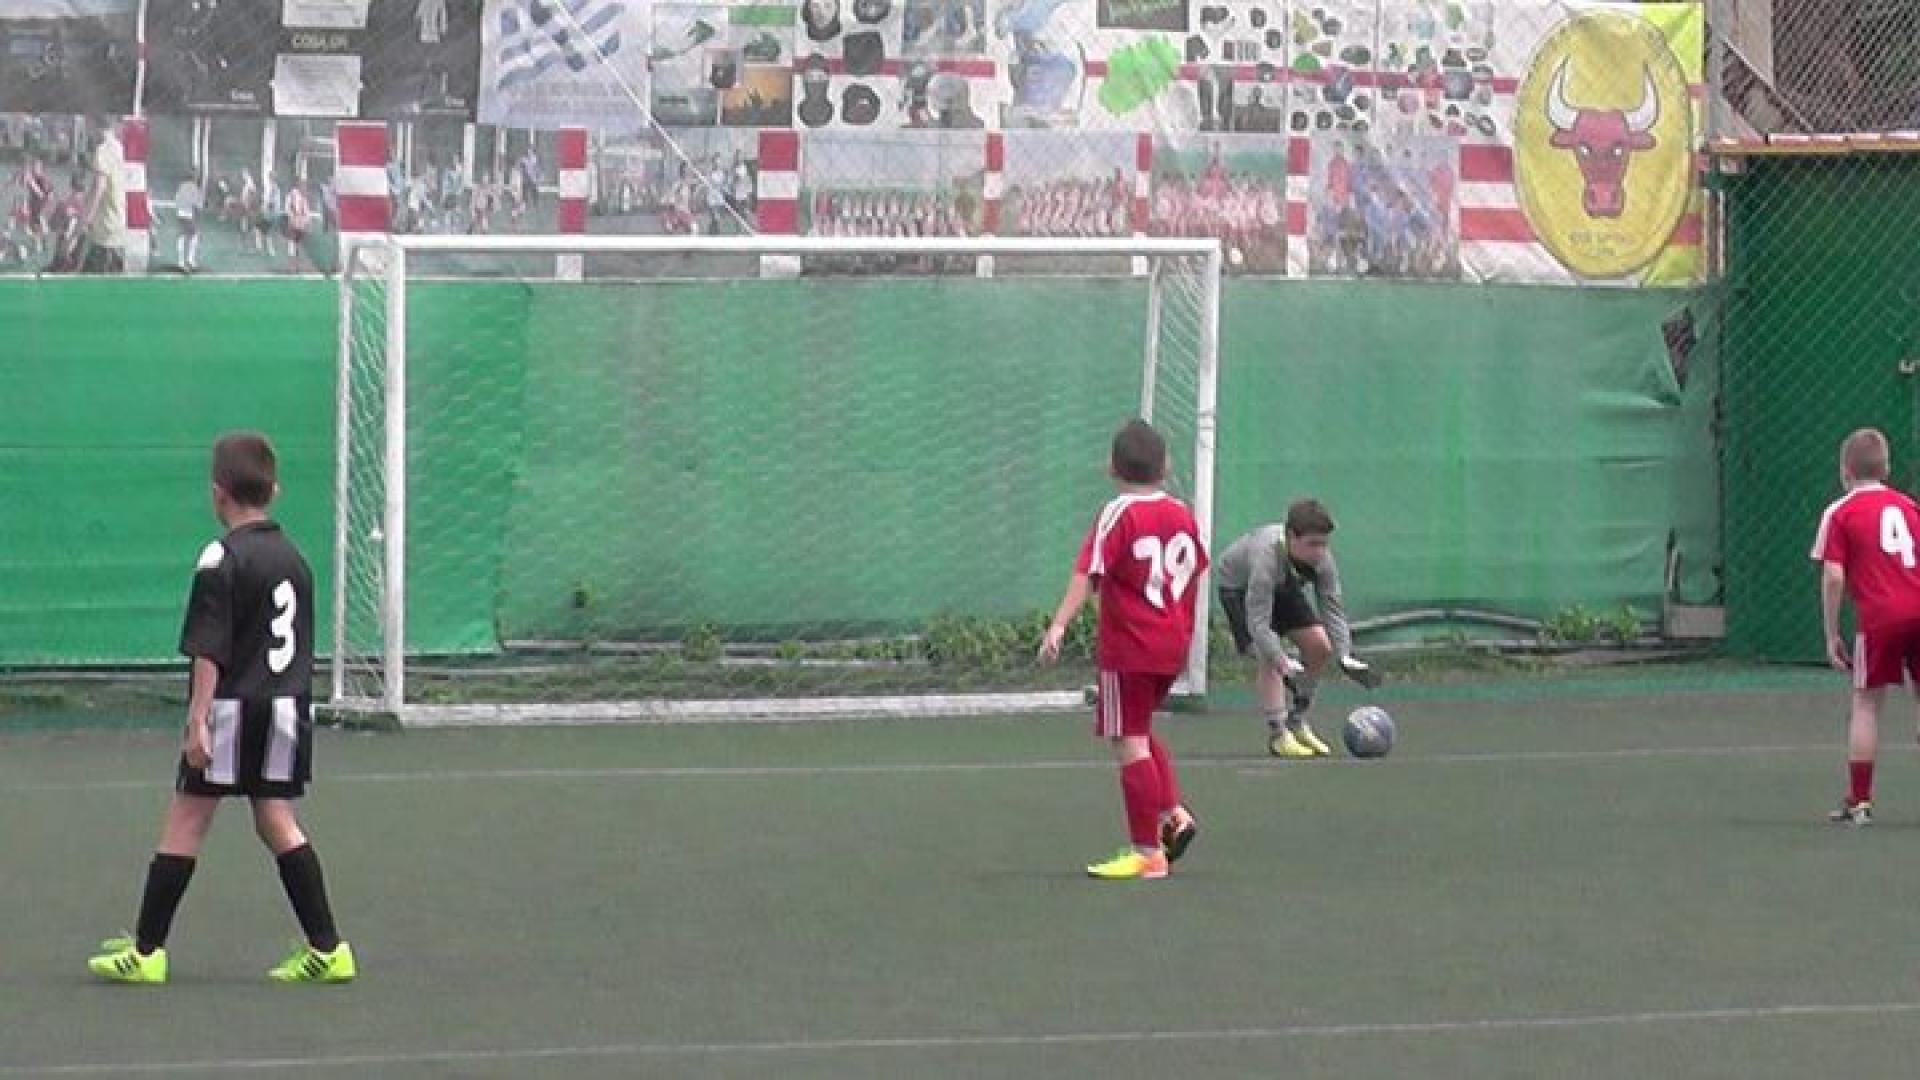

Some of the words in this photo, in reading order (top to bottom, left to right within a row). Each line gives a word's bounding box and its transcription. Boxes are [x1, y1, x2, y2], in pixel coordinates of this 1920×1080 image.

[1132, 532, 1197, 609] 19
[1880, 505, 1916, 569] 4
[268, 580, 297, 673] 3
